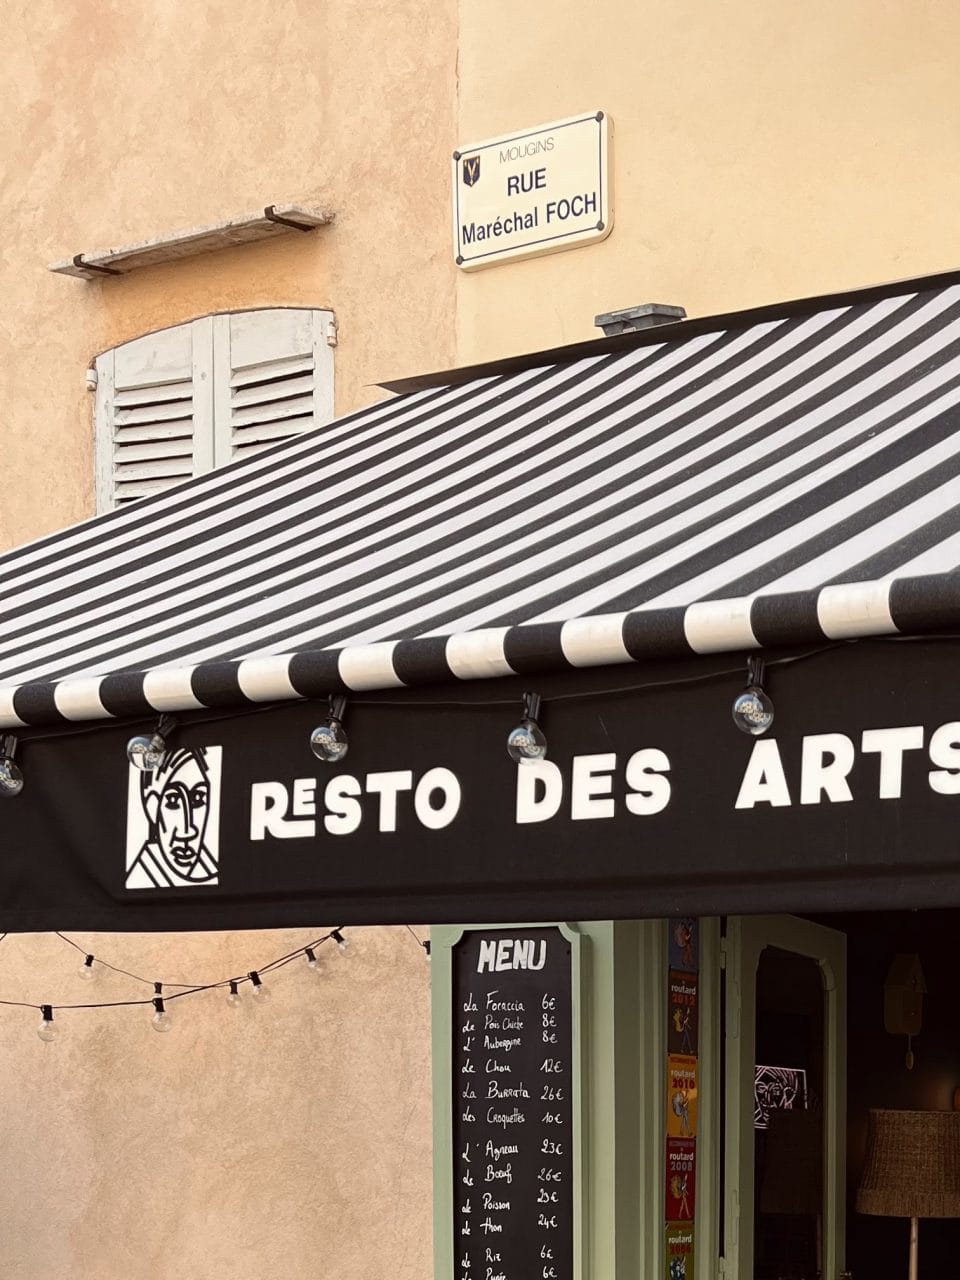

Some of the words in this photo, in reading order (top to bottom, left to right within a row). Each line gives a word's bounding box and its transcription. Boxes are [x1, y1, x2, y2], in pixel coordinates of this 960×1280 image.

[499, 137, 555, 164] MOUGINS
[507, 168, 547, 197] RUE
[462, 206, 539, 245] Maréchal
[546, 192, 597, 224] FOCH
[517, 748, 672, 824] DES
[477, 939, 547, 974] MENU
[671, 984, 697, 995] routard
[463, 992, 479, 1012] La
[541, 993, 556, 1010] 6€
[462, 1019, 476, 1033] Le
[484, 1014, 500, 1031] Pois
[542, 1013, 557, 1028] 8€
[484, 1035, 522, 1052] Aubergine
[542, 1030, 558, 1044] 8€
[461, 1058, 477, 1073] Le
[485, 1059, 512, 1073] Chou
[539, 1059, 563, 1073] 12€
[462, 1082, 477, 1099] La
[540, 1085, 564, 1101] 26€
[672, 1078, 695, 1089] 2010
[462, 1105, 476, 1122] Les
[542, 1112, 563, 1124] 10€
[485, 1139, 519, 1161] Agneau
[541, 1138, 563, 1155] 23€
[669, 1152, 694, 1161] routard
[671, 1161, 693, 1171] 2008
[462, 1168, 474, 1186] Le
[537, 1167, 562, 1182] 26€
[482, 1192, 511, 1210] Poisson
[538, 1213, 558, 1229] 24€
[668, 1233, 692, 1244] routard
[485, 1247, 502, 1263] Riz
[540, 1244, 553, 1259] 6€
[542, 1266, 558, 1279] 6€
